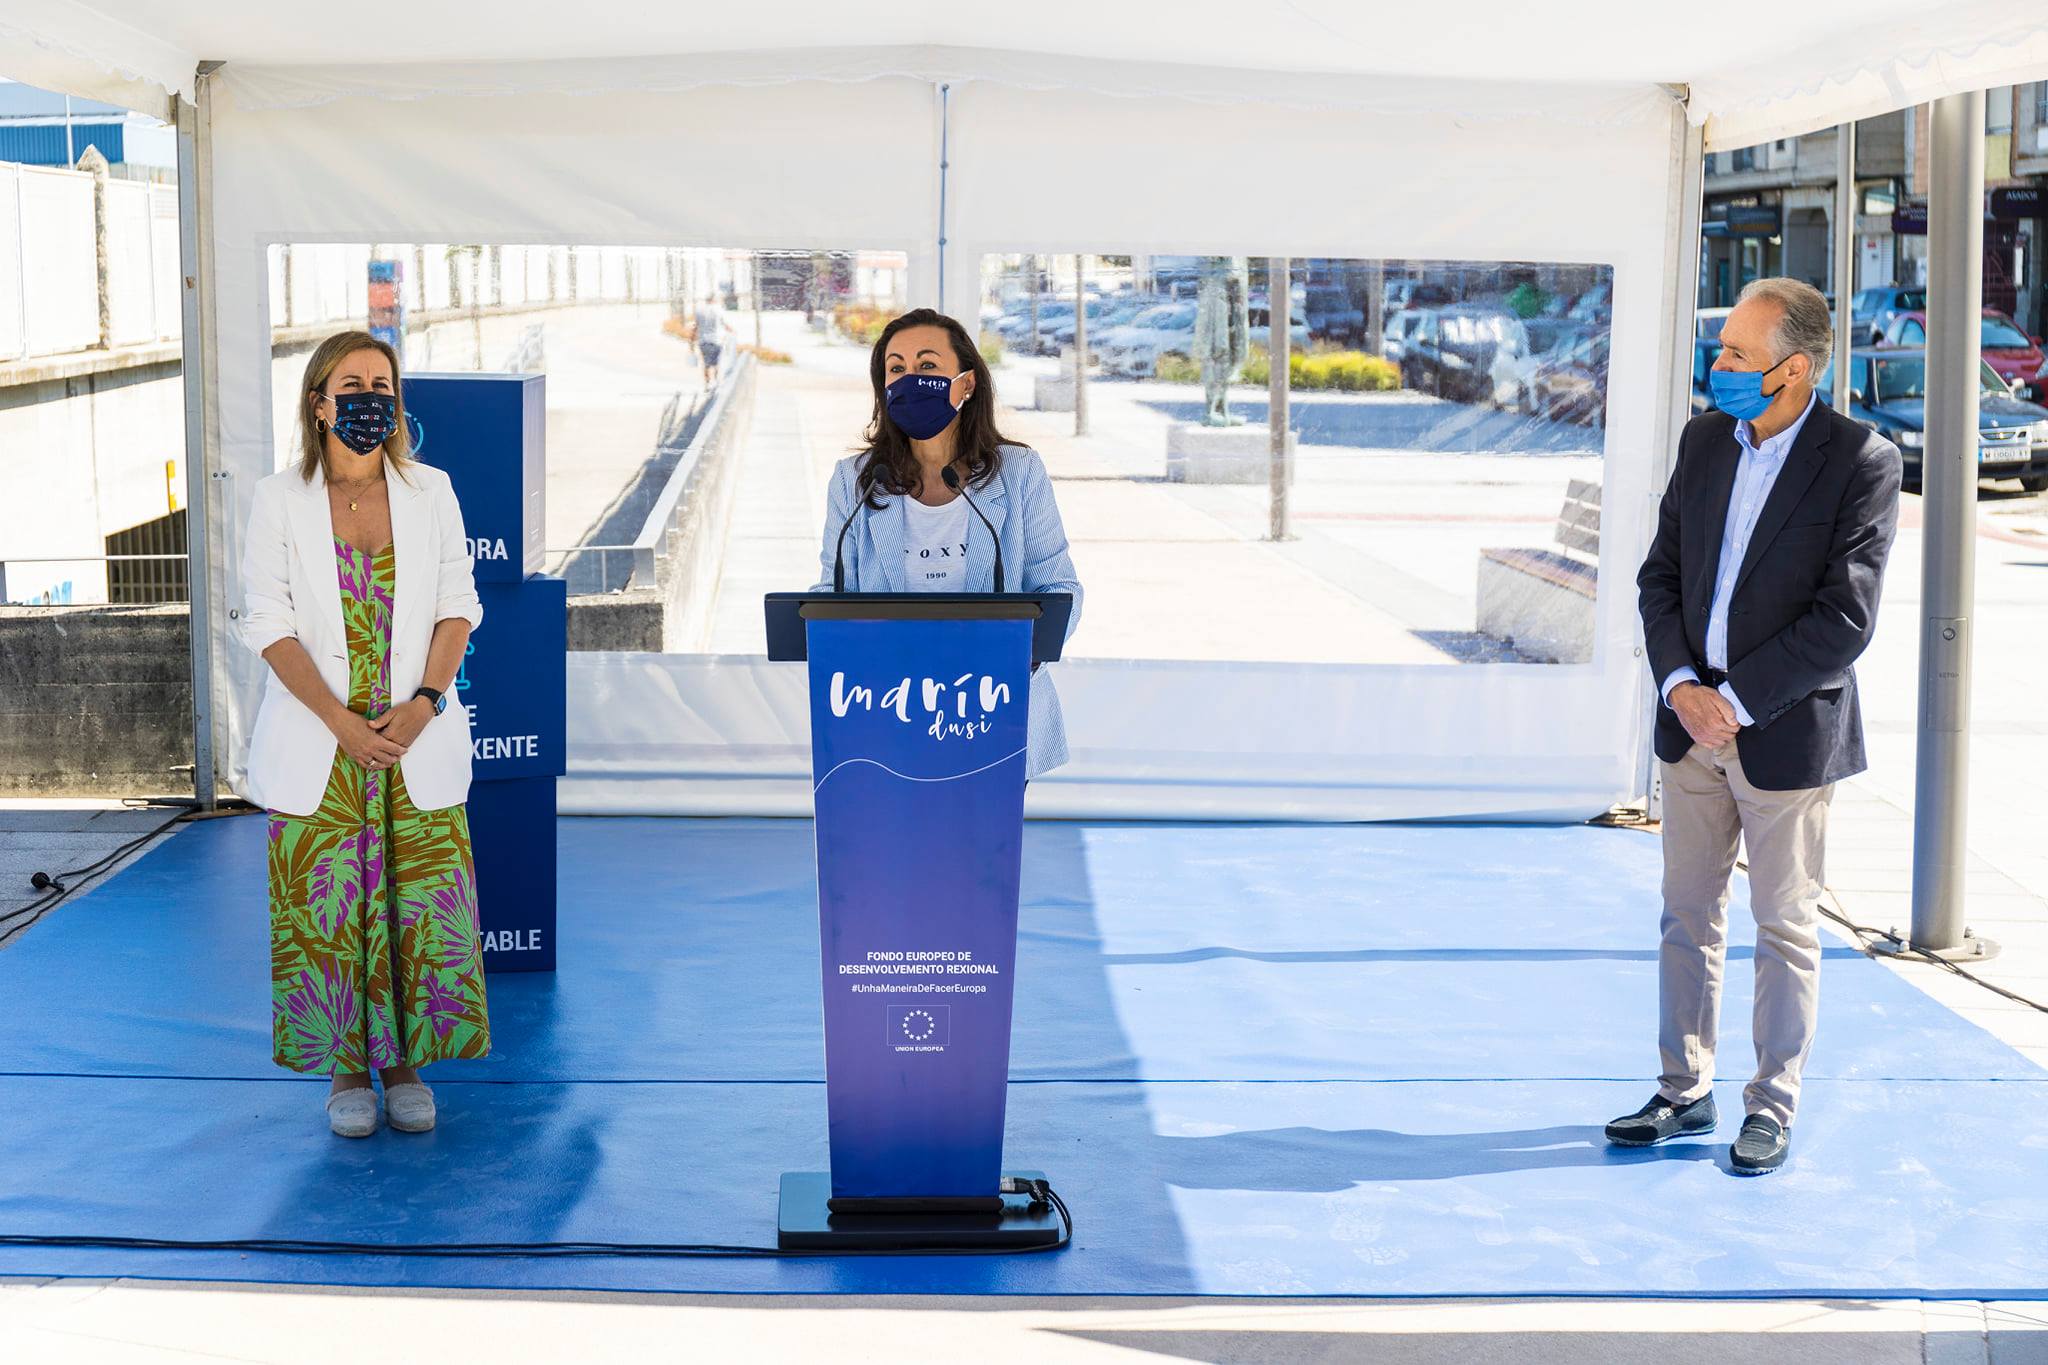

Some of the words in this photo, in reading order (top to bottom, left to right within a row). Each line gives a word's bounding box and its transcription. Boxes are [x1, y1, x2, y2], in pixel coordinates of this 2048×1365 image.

[2006, 190, 2038, 200] ASADOR
[926, 572, 947, 580] 1990
[829, 671, 1011, 723] marín
[928, 709, 992, 741] dusi
[867, 951, 903, 961] FONDO
[906, 951, 955, 961] EUROPEO
[957, 951, 972, 961] DE
[839, 964, 944, 975] DESENVOLVEMENTO
[946, 964, 999, 974] REXIONAL
[851, 983, 987, 994] #UnhaManeiraDeFacerEuropa
